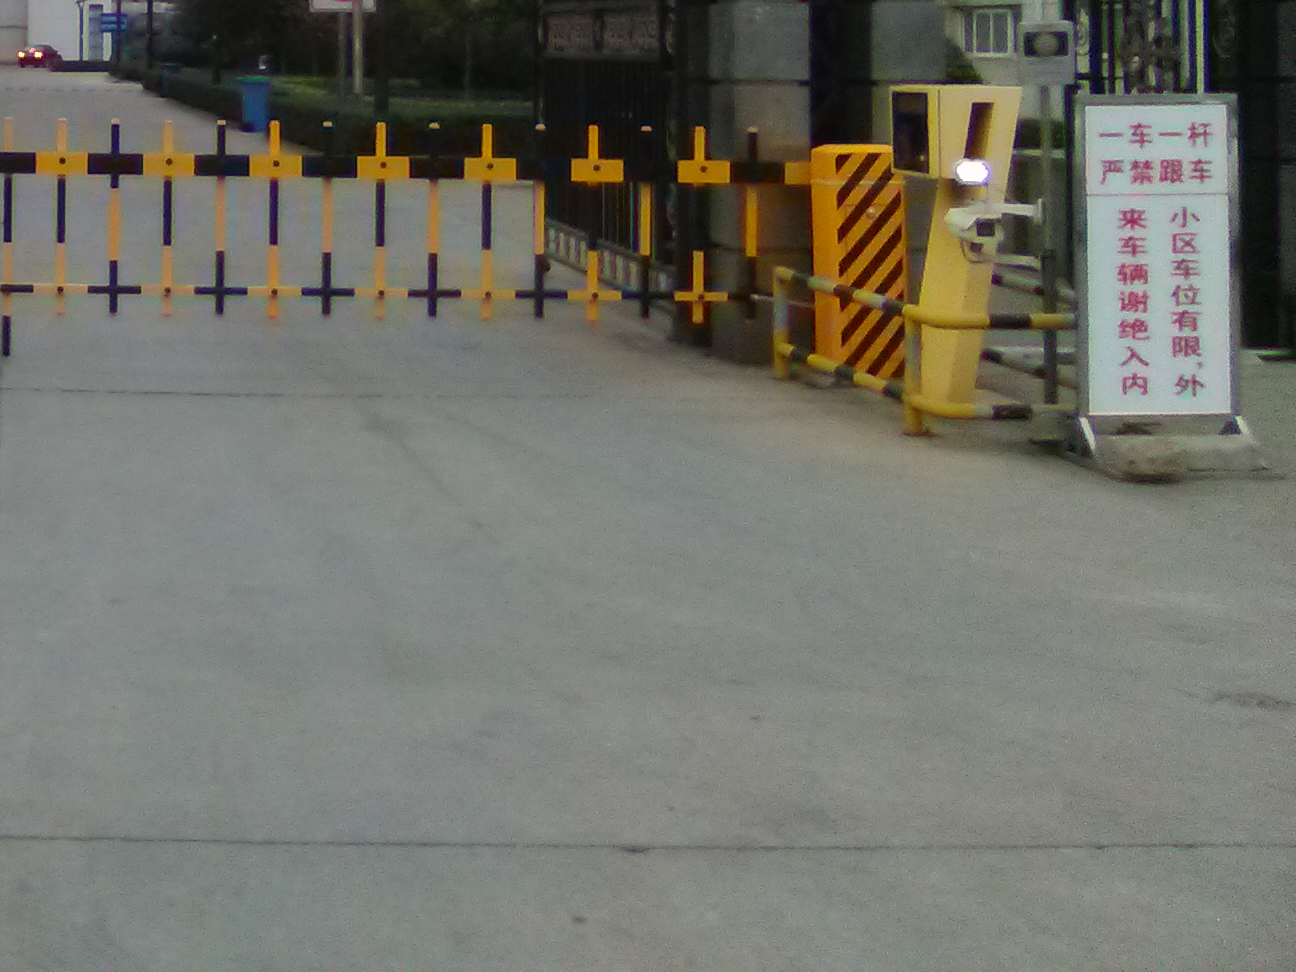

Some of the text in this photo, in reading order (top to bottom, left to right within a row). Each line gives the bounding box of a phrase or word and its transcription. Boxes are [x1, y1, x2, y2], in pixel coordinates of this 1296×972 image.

[1098, 122, 1213, 148] 一车一杆
[1100, 159, 1213, 185] 严禁跟车
[1116, 208, 1150, 396] 来车辆谢绝入内
